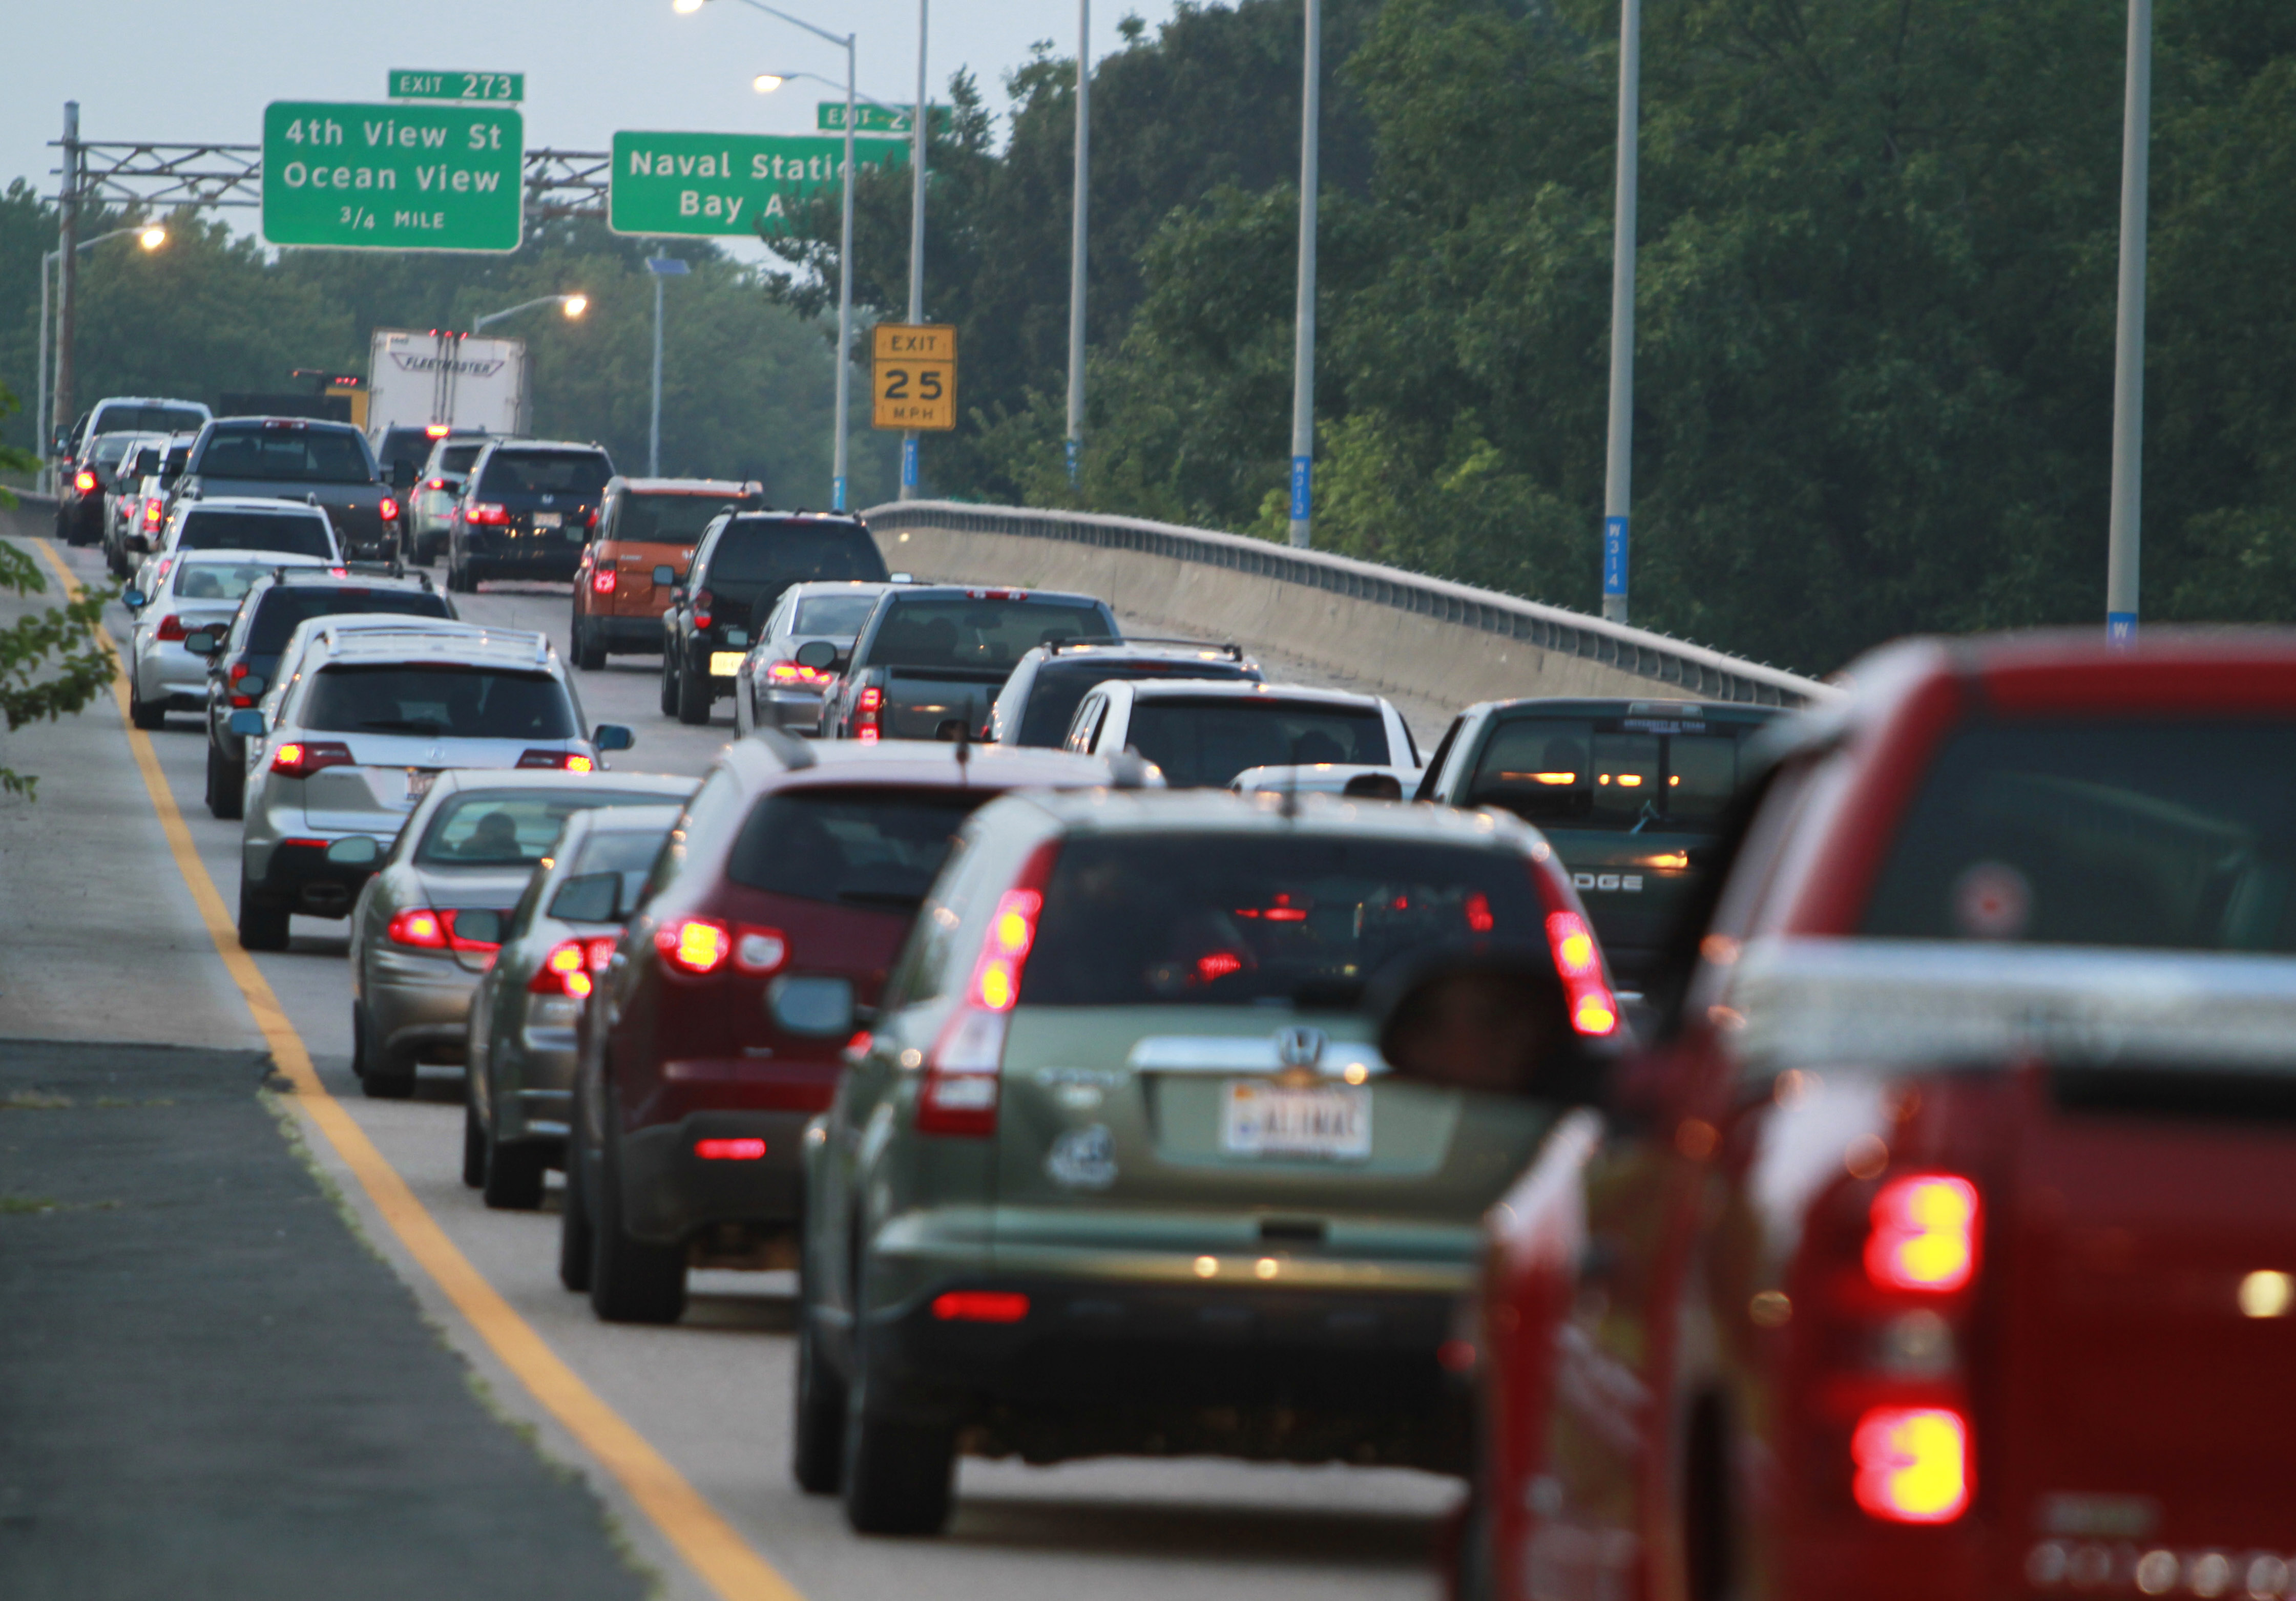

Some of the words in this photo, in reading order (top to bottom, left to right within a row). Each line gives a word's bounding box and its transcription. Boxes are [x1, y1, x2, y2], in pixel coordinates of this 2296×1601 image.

[400, 76, 444, 93] EXIT
[463, 74, 512, 99] 273
[285, 118, 343, 145] 4th
[364, 120, 447, 148] View
[468, 123, 502, 150] St
[283, 161, 396, 190] Ocean
[416, 164, 500, 193] View
[630, 151, 731, 179] Naval
[340, 206, 376, 230] 3/4
[393, 211, 445, 229] MILE
[680, 191, 744, 225] Bay
[891, 336, 936, 351] EXIT
[885, 369, 942, 400] 25
[1609, 523, 1621, 586] W314
[1573, 873, 1643, 893] DGE
